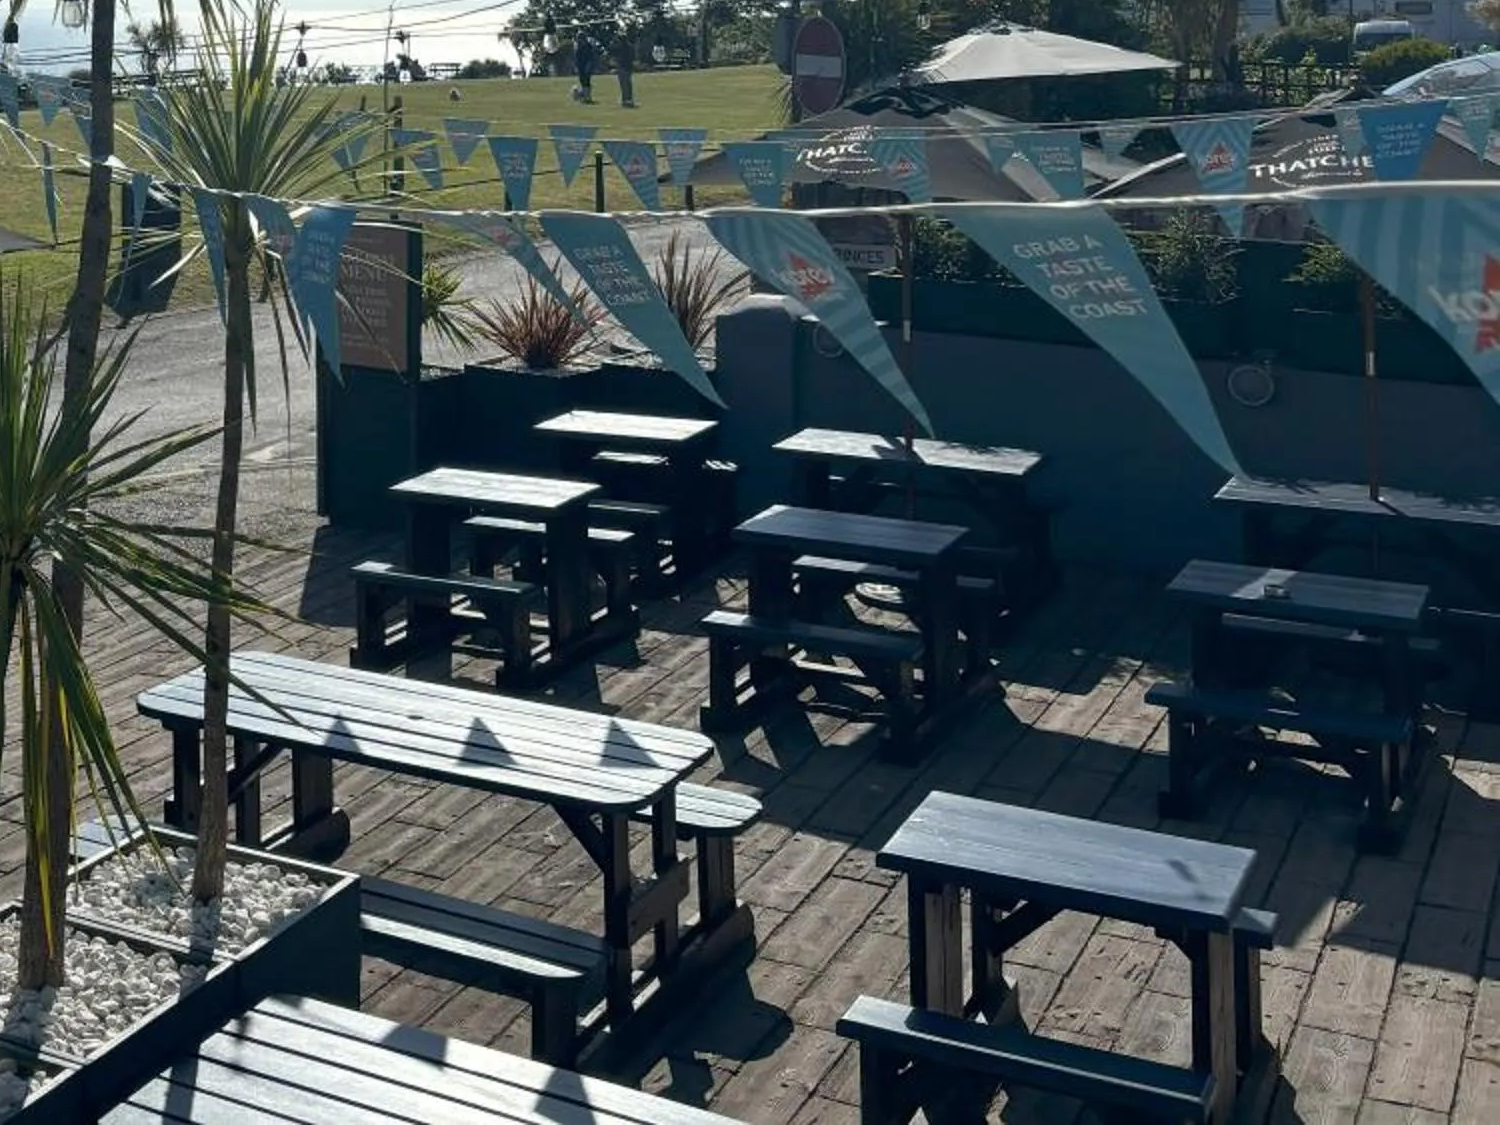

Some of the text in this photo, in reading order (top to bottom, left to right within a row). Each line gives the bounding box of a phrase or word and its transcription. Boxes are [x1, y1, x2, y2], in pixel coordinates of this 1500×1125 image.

[1248, 154, 1375, 177] THATCHE
[1013, 234, 1103, 259] GRAB A
[1035, 254, 1114, 278] TASTE
[1049, 275, 1136, 300] OF THE
[1068, 297, 1148, 319] COAST
